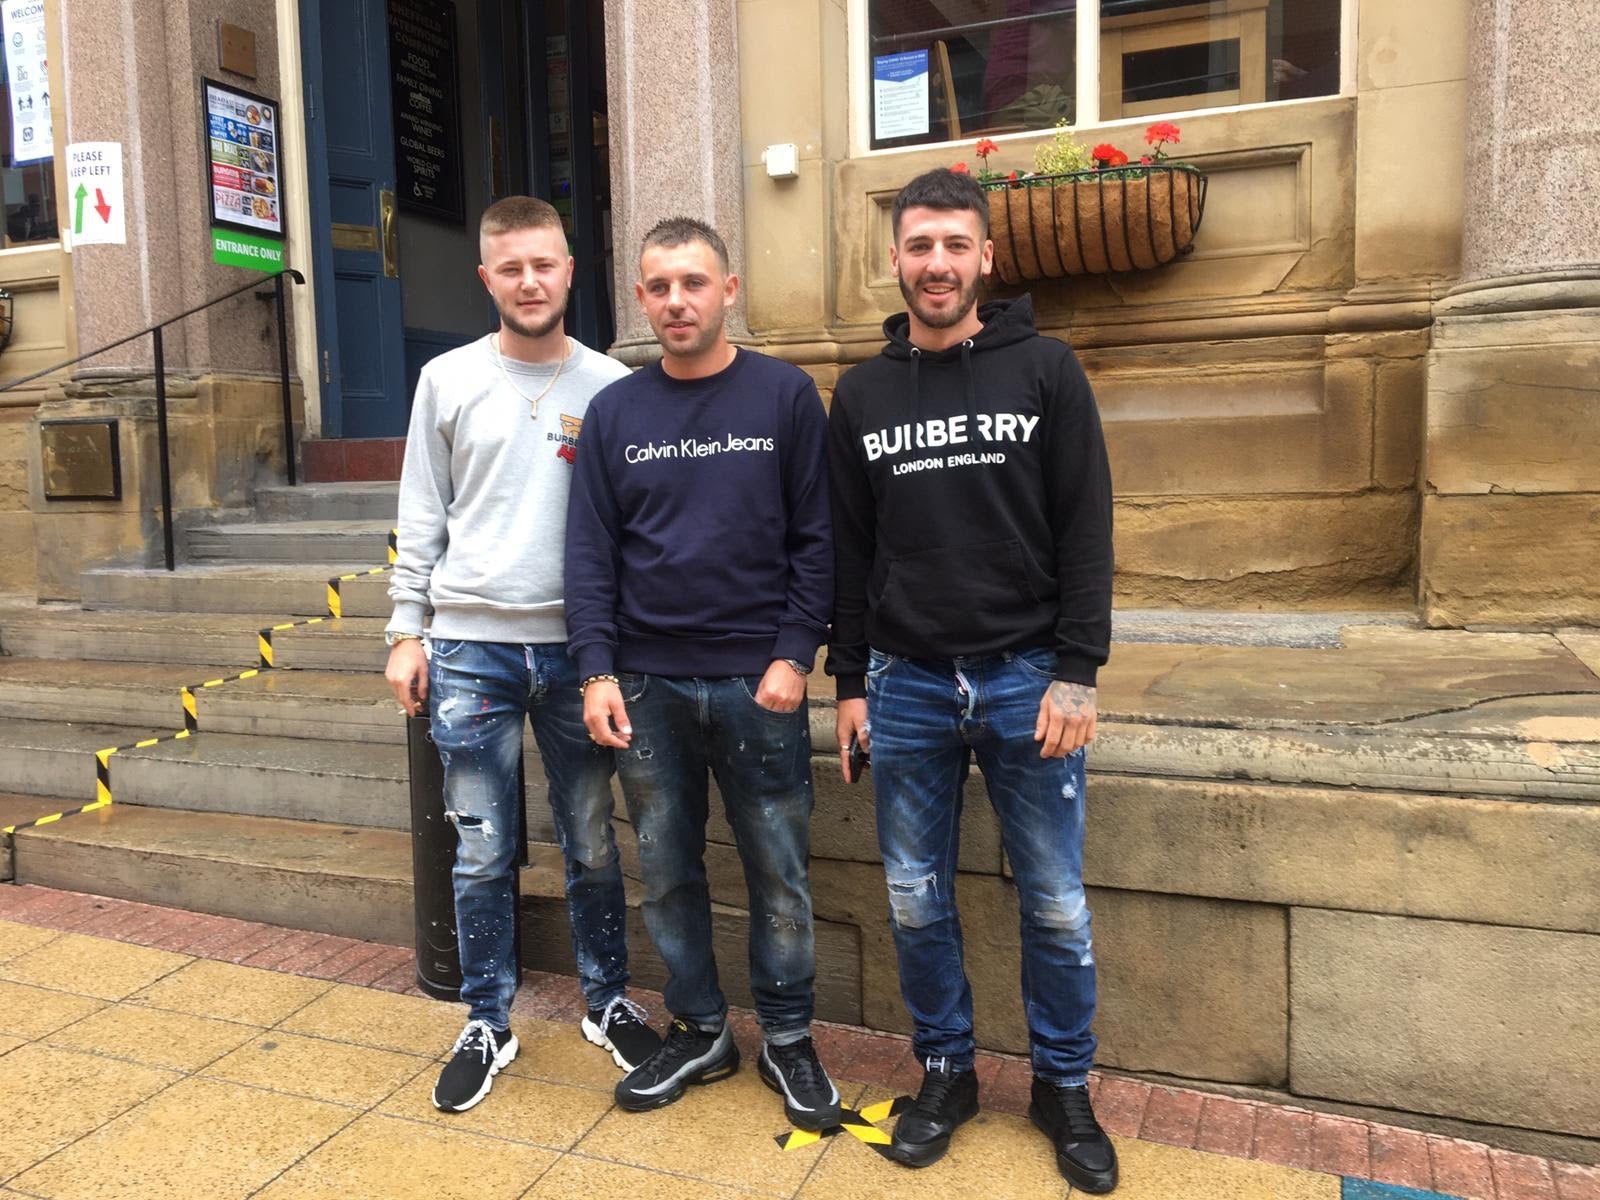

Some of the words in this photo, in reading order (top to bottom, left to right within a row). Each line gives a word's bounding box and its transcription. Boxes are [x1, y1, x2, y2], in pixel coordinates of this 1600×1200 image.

[400, 136, 426, 152] GLOBAL
[73, 151, 103, 162] PLEASE
[89, 165, 111, 176] LEFT
[215, 191, 240, 209] PIZZA
[215, 238, 260, 258] ENTRANCE
[260, 247, 281, 262] ONLY
[862, 413, 1040, 461] BURBERRY
[625, 440, 678, 464] Calvin
[680, 437, 721, 458] Klein
[722, 433, 775, 453] Jeans
[893, 458, 944, 476] LONDON
[947, 453, 1006, 468] ENGLAND
